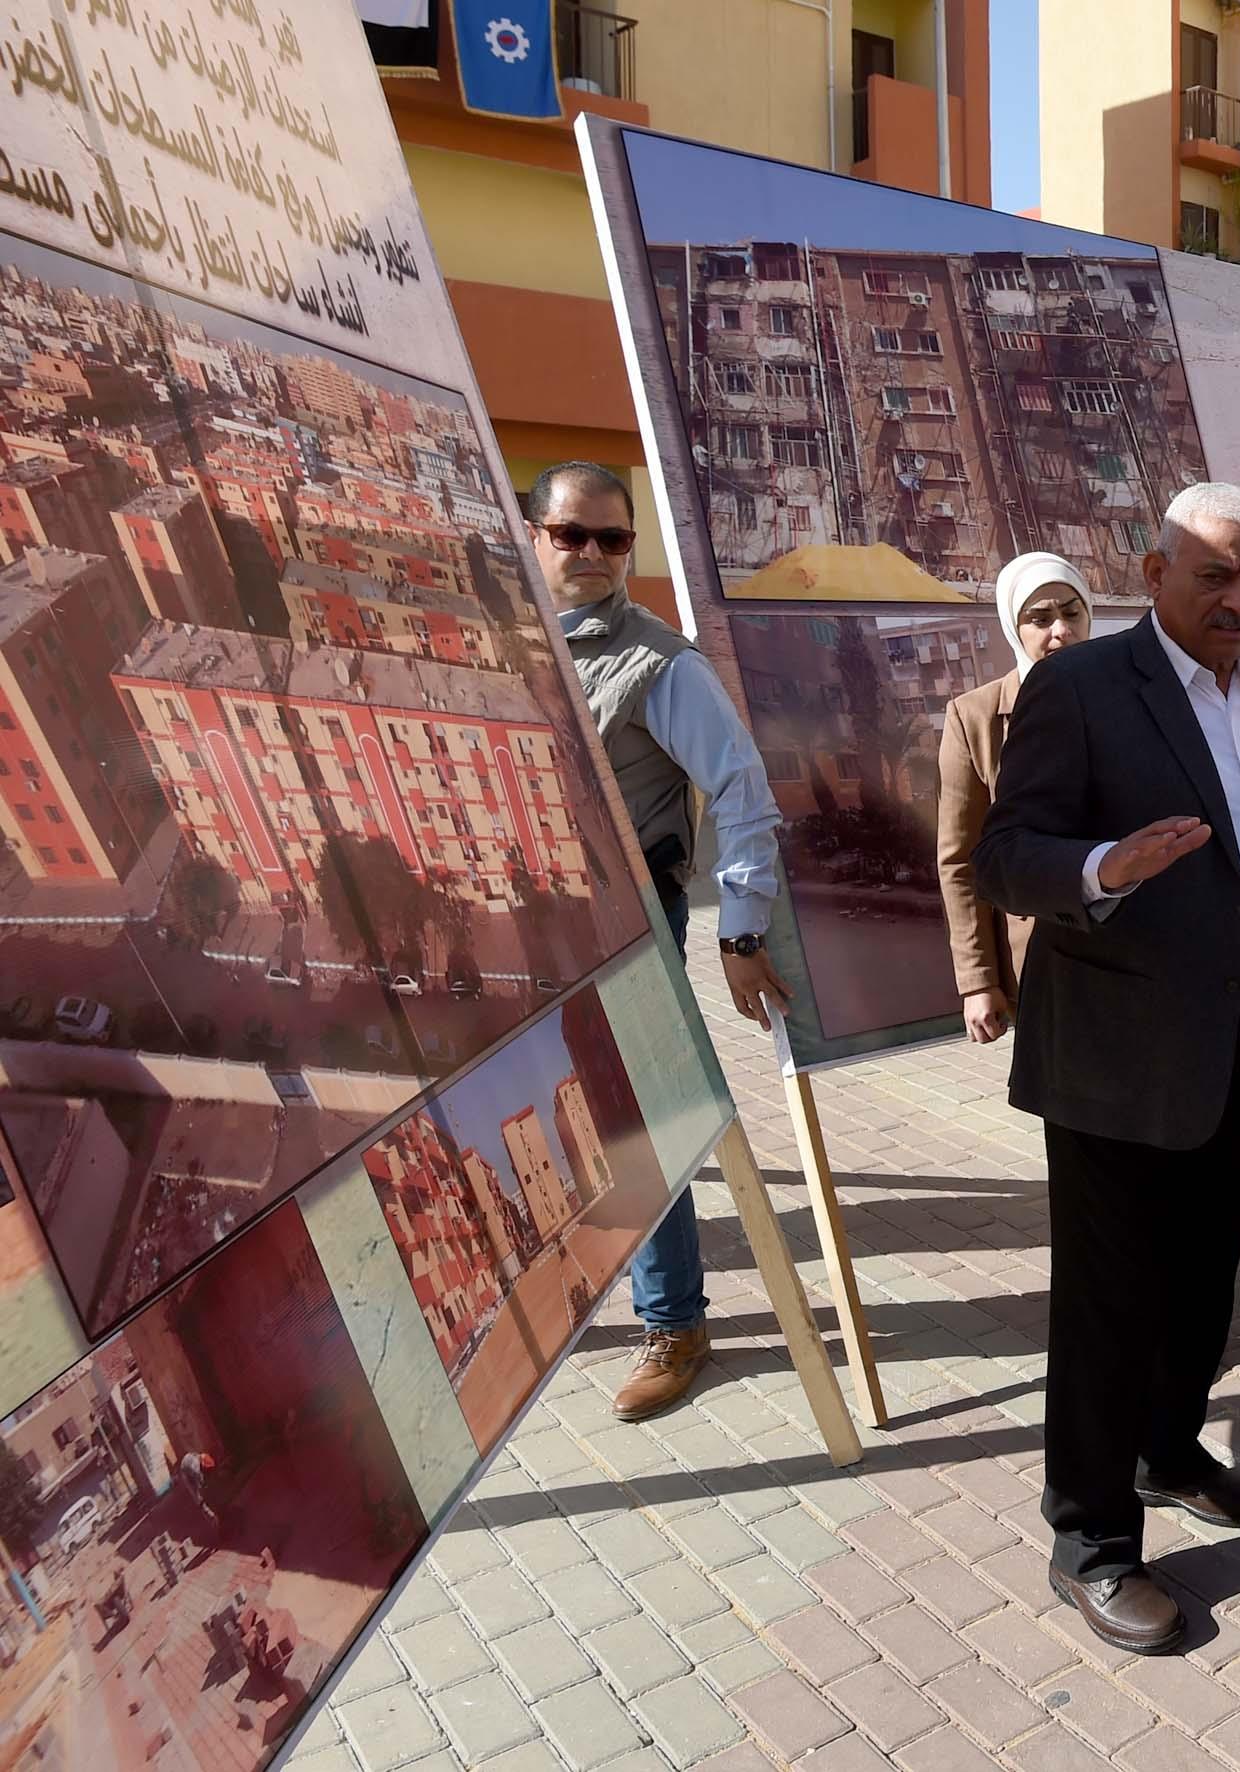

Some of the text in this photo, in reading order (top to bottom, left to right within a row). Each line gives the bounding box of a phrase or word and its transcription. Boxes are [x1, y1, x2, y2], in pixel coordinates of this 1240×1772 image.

[142, 9, 178, 70] من
[90, 48, 225, 182] المسطحات
[184, 196, 251, 290] انتظار
[316, 176, 381, 275] وتجميل
[380, 216, 420, 286] تطوير
[250, 229, 320, 317] ساحات
